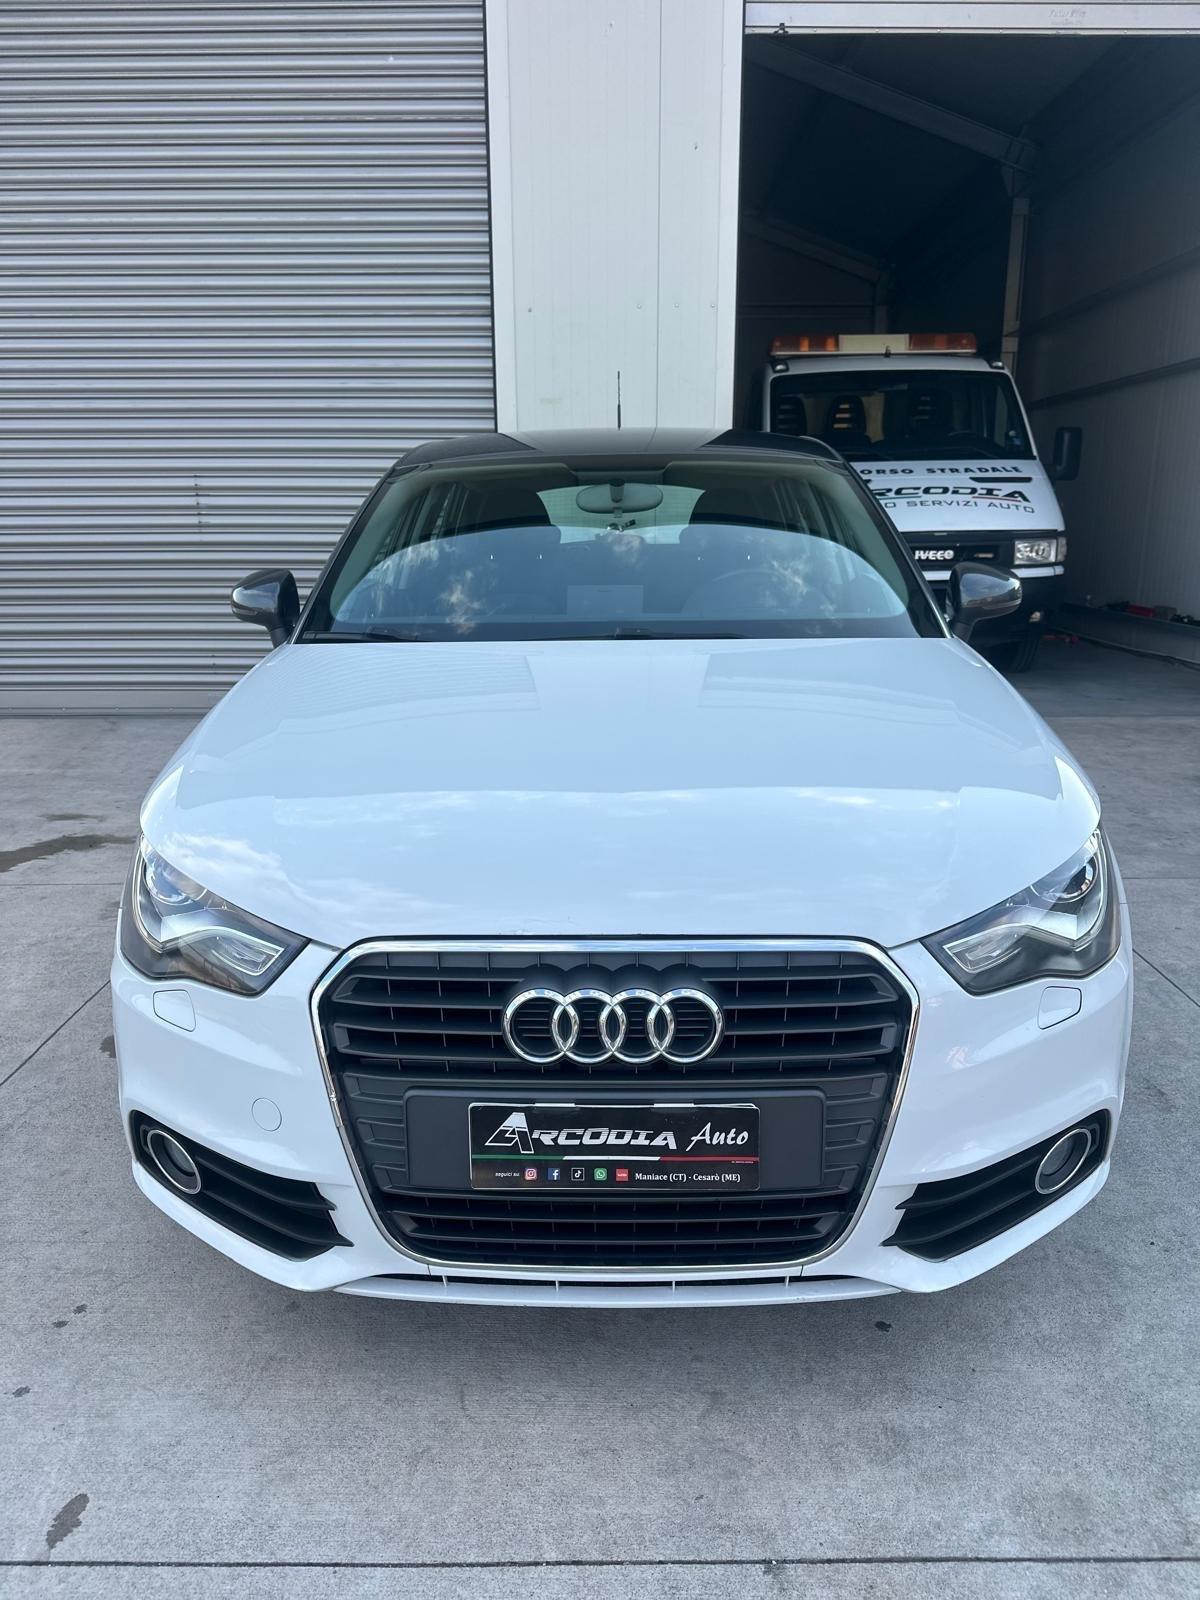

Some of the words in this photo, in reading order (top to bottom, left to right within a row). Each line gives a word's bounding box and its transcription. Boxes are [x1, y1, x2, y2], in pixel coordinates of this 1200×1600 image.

[926, 466, 1022, 475] STRADALE
[863, 479, 1031, 503] RCODIA
[906, 499, 978, 508] SERVIZI
[987, 502, 1035, 514] AUTO
[914, 550, 954, 560] IVECO
[484, 1111, 677, 1154] ARCODIA
[686, 1122, 749, 1151] Auto
[635, 1172, 668, 1181] Maniace
[669, 1173, 687, 1182] (CT)
[692, 1173, 720, 1181] Cesarò
[721, 1173, 741, 1183] (ME)
